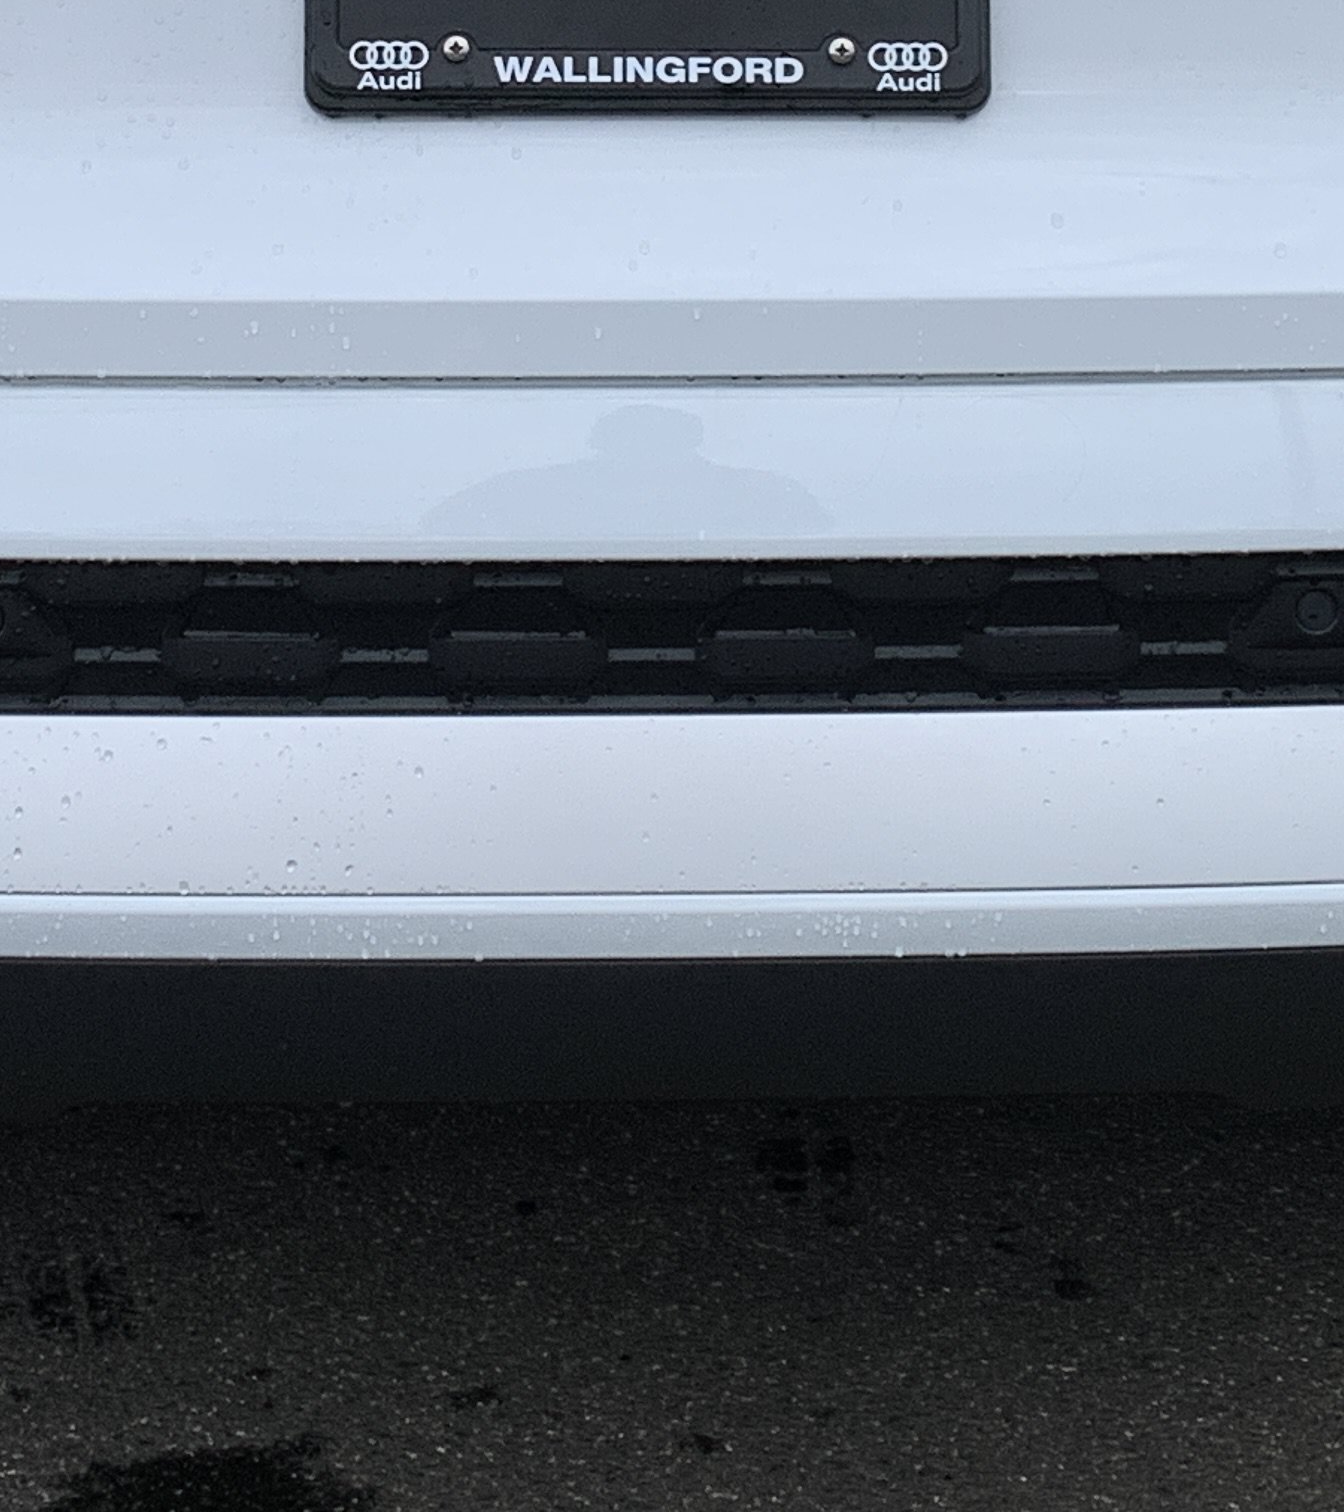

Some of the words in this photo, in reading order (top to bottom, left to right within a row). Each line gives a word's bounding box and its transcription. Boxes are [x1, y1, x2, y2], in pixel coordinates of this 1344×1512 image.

[493, 54, 805, 85] WALLINGFORD
[356, 70, 423, 91] Audi
[875, 72, 942, 92] Audi
